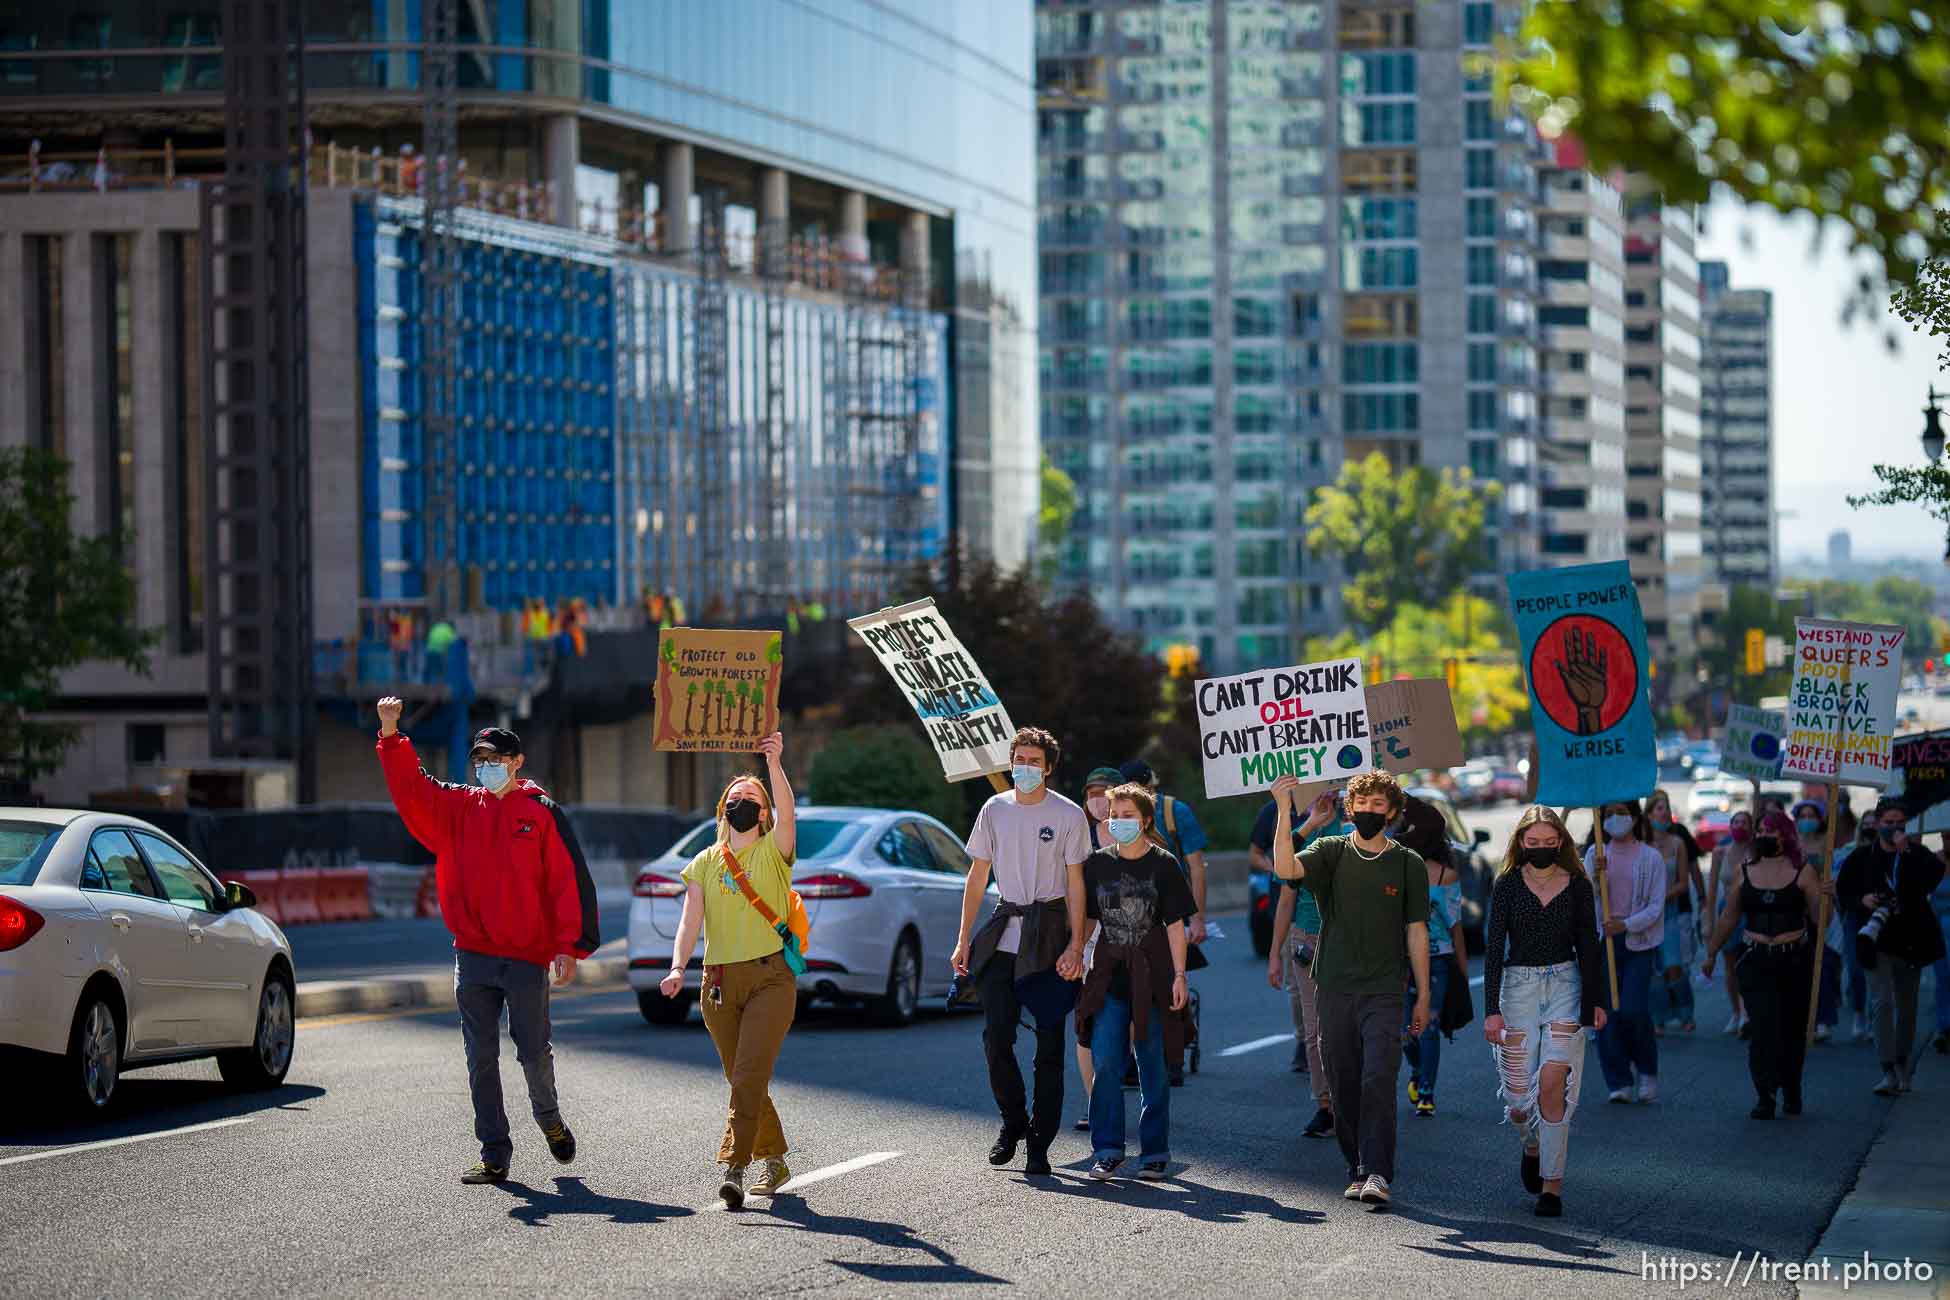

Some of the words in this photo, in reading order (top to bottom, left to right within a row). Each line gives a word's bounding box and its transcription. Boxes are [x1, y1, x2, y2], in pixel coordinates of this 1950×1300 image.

[1516, 593, 1571, 615] PEOPLE
[1577, 584, 1629, 609] POWER
[862, 615, 947, 655] PROTECT
[682, 648, 726, 662] PROTECT
[736, 651, 756, 662] OLD
[902, 646, 933, 661] OUR
[1802, 646, 1889, 668] QUEERS
[680, 667, 718, 678] GROWTH
[721, 667, 767, 680] FORESTS
[893, 651, 979, 690] CLIMATE
[910, 680, 989, 714] WATER
[1199, 676, 1264, 716] CAN'T
[1274, 663, 1359, 700] DRINK
[1800, 677, 1869, 699] BLACK
[1260, 698, 1313, 724] OIL
[1797, 694, 1869, 715] BROWN
[942, 712, 971, 722] AND
[1796, 711, 1877, 734] NATIVE
[930, 712, 1008, 752] HEALTH
[1203, 724, 1264, 759] CAN'T
[1270, 710, 1368, 749] BREATHE
[1793, 730, 1892, 753] IMMIGRANT
[1241, 746, 1327, 786] MONEY
[1787, 759, 1838, 774] ABLED
[1790, 743, 1891, 771] DIFFERENTLY
